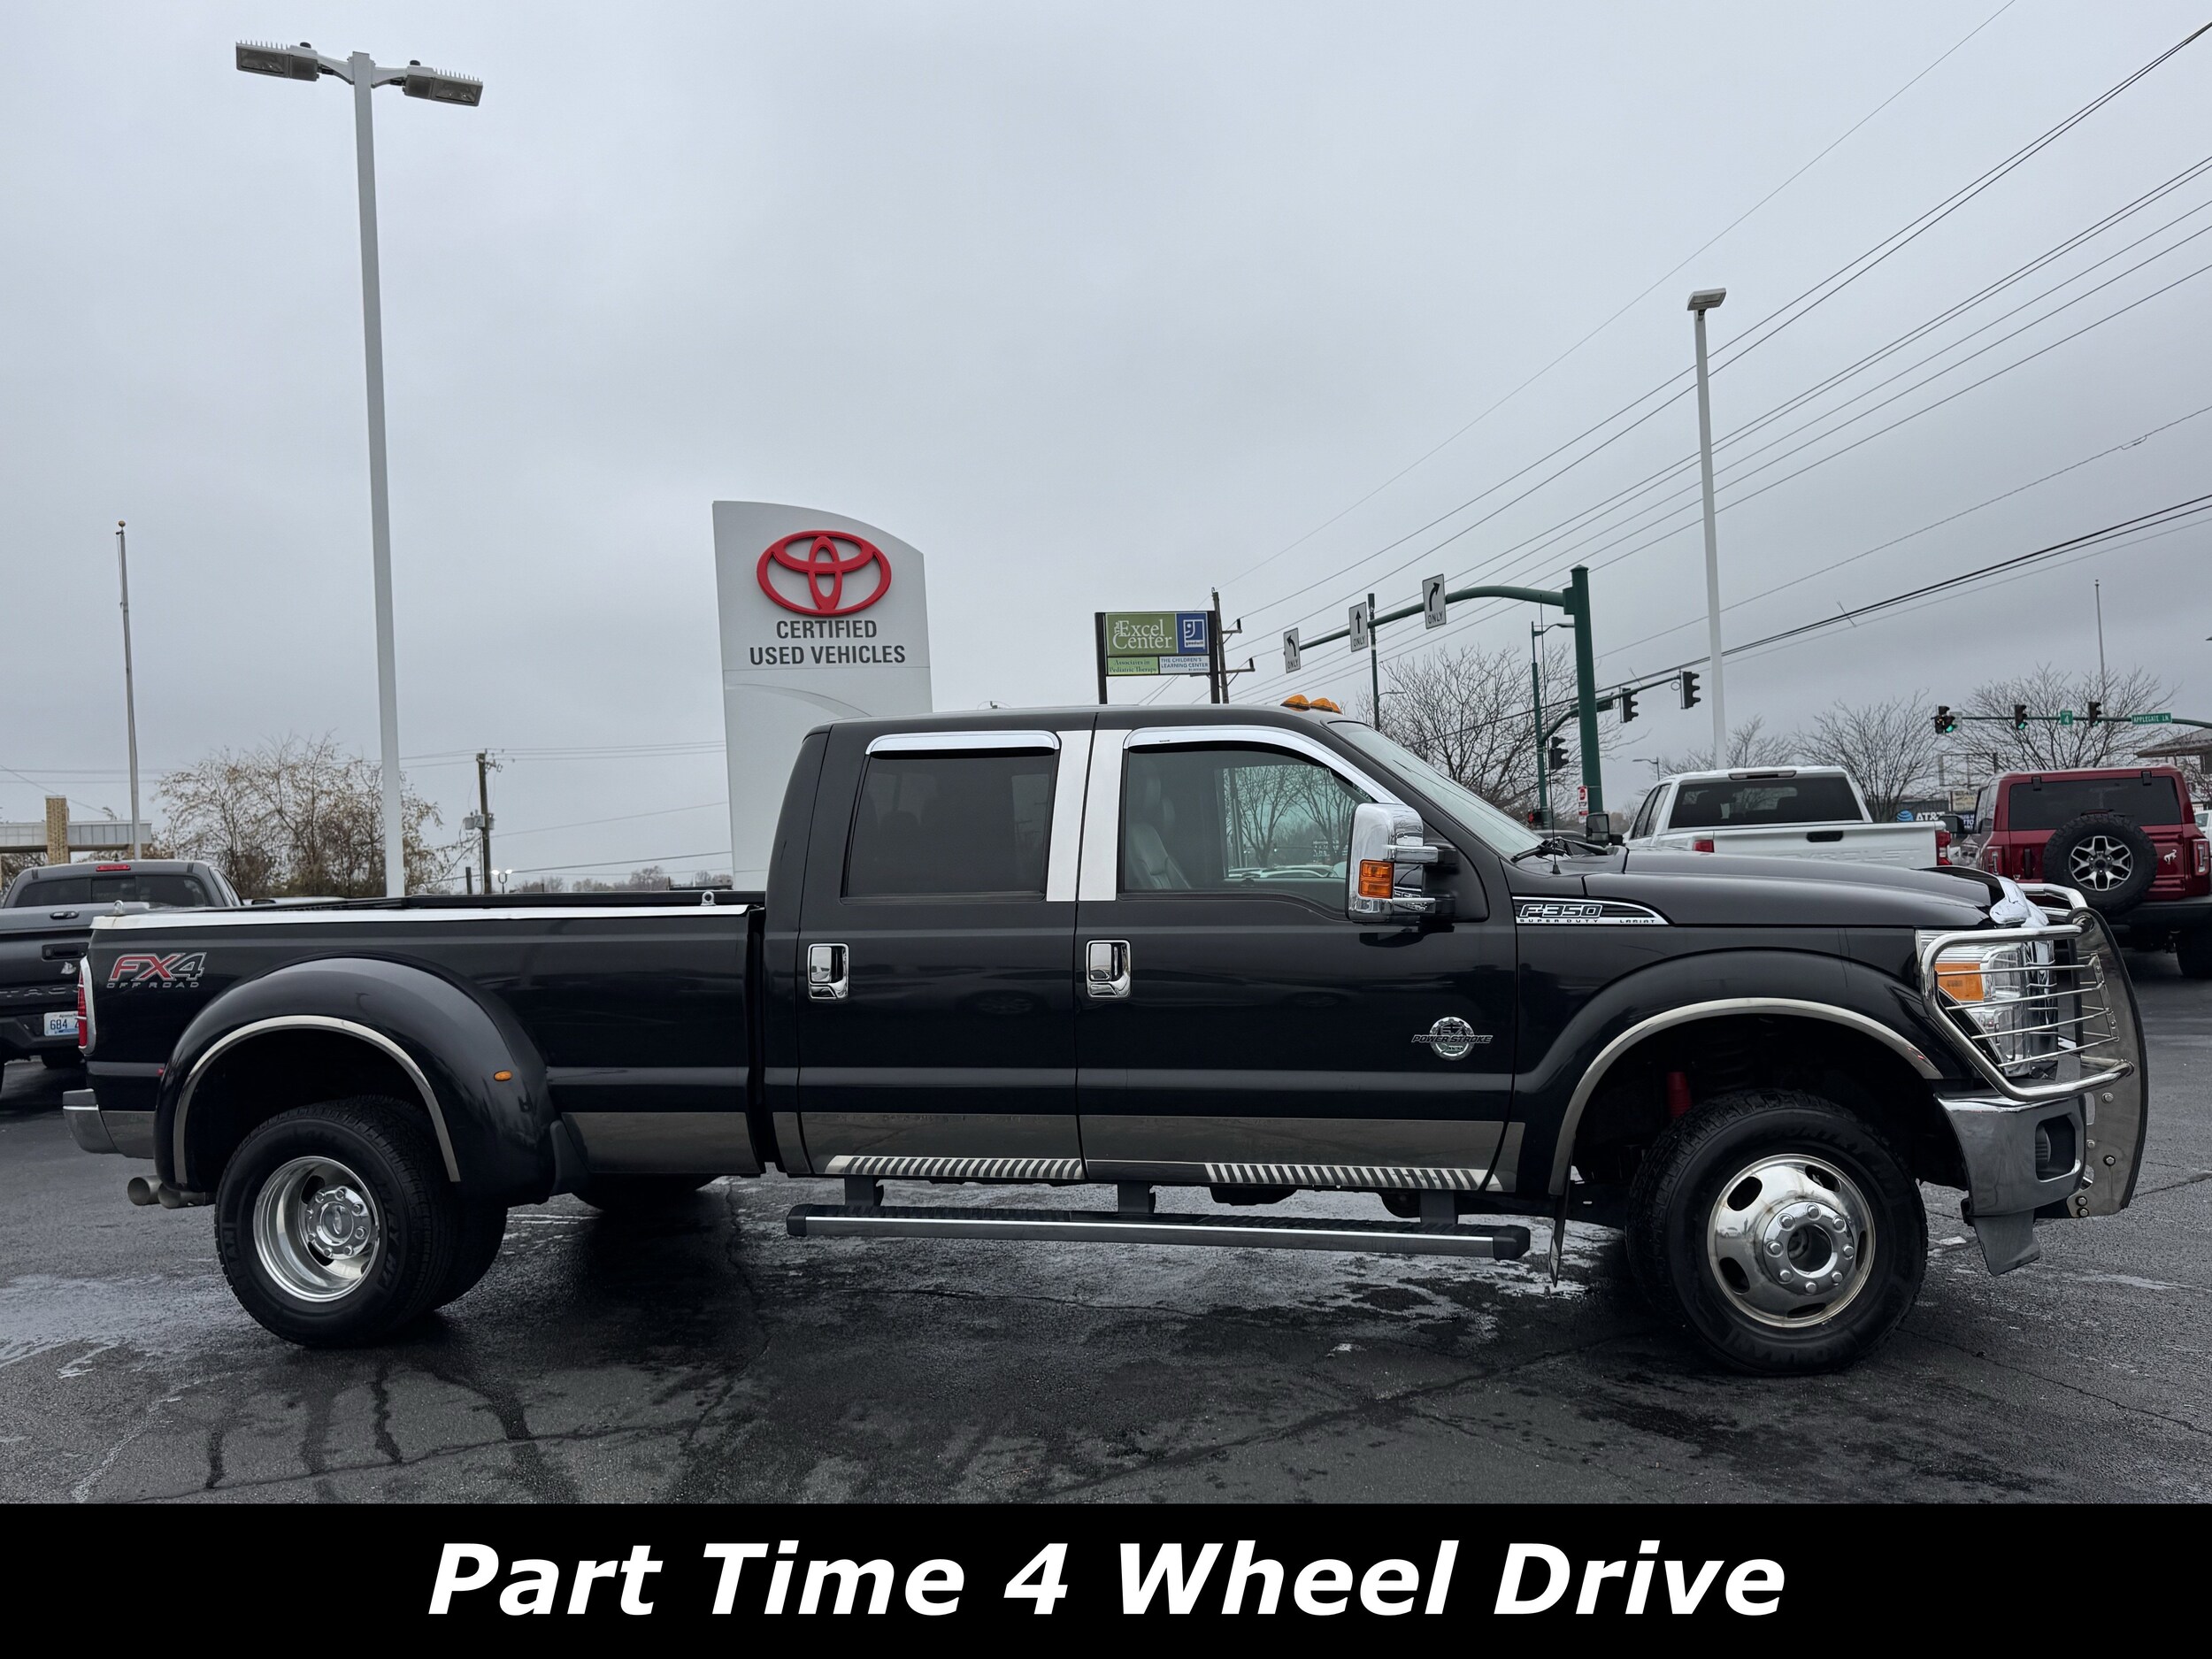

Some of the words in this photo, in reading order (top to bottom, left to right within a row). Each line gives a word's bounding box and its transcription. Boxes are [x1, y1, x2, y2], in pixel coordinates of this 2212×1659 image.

[1427, 611, 1443, 625] ONLY
[776, 619, 878, 639] CERTIFIED
[1118, 618, 1165, 637] Excel
[1112, 633, 1172, 649] Center
[1353, 636, 1366, 647] ONLY
[749, 646, 804, 664] USED
[810, 645, 906, 664] VEHICLES
[1286, 658, 1299, 670] ONLY
[2133, 714, 2160, 724] APPLEGATE
[1518, 903, 1603, 918] F-350
[108, 952, 207, 981] FX4
[50, 1018, 67, 1030] 684
[1411, 1034, 1448, 1043] POWER
[1449, 1034, 1494, 1043] STROKE
